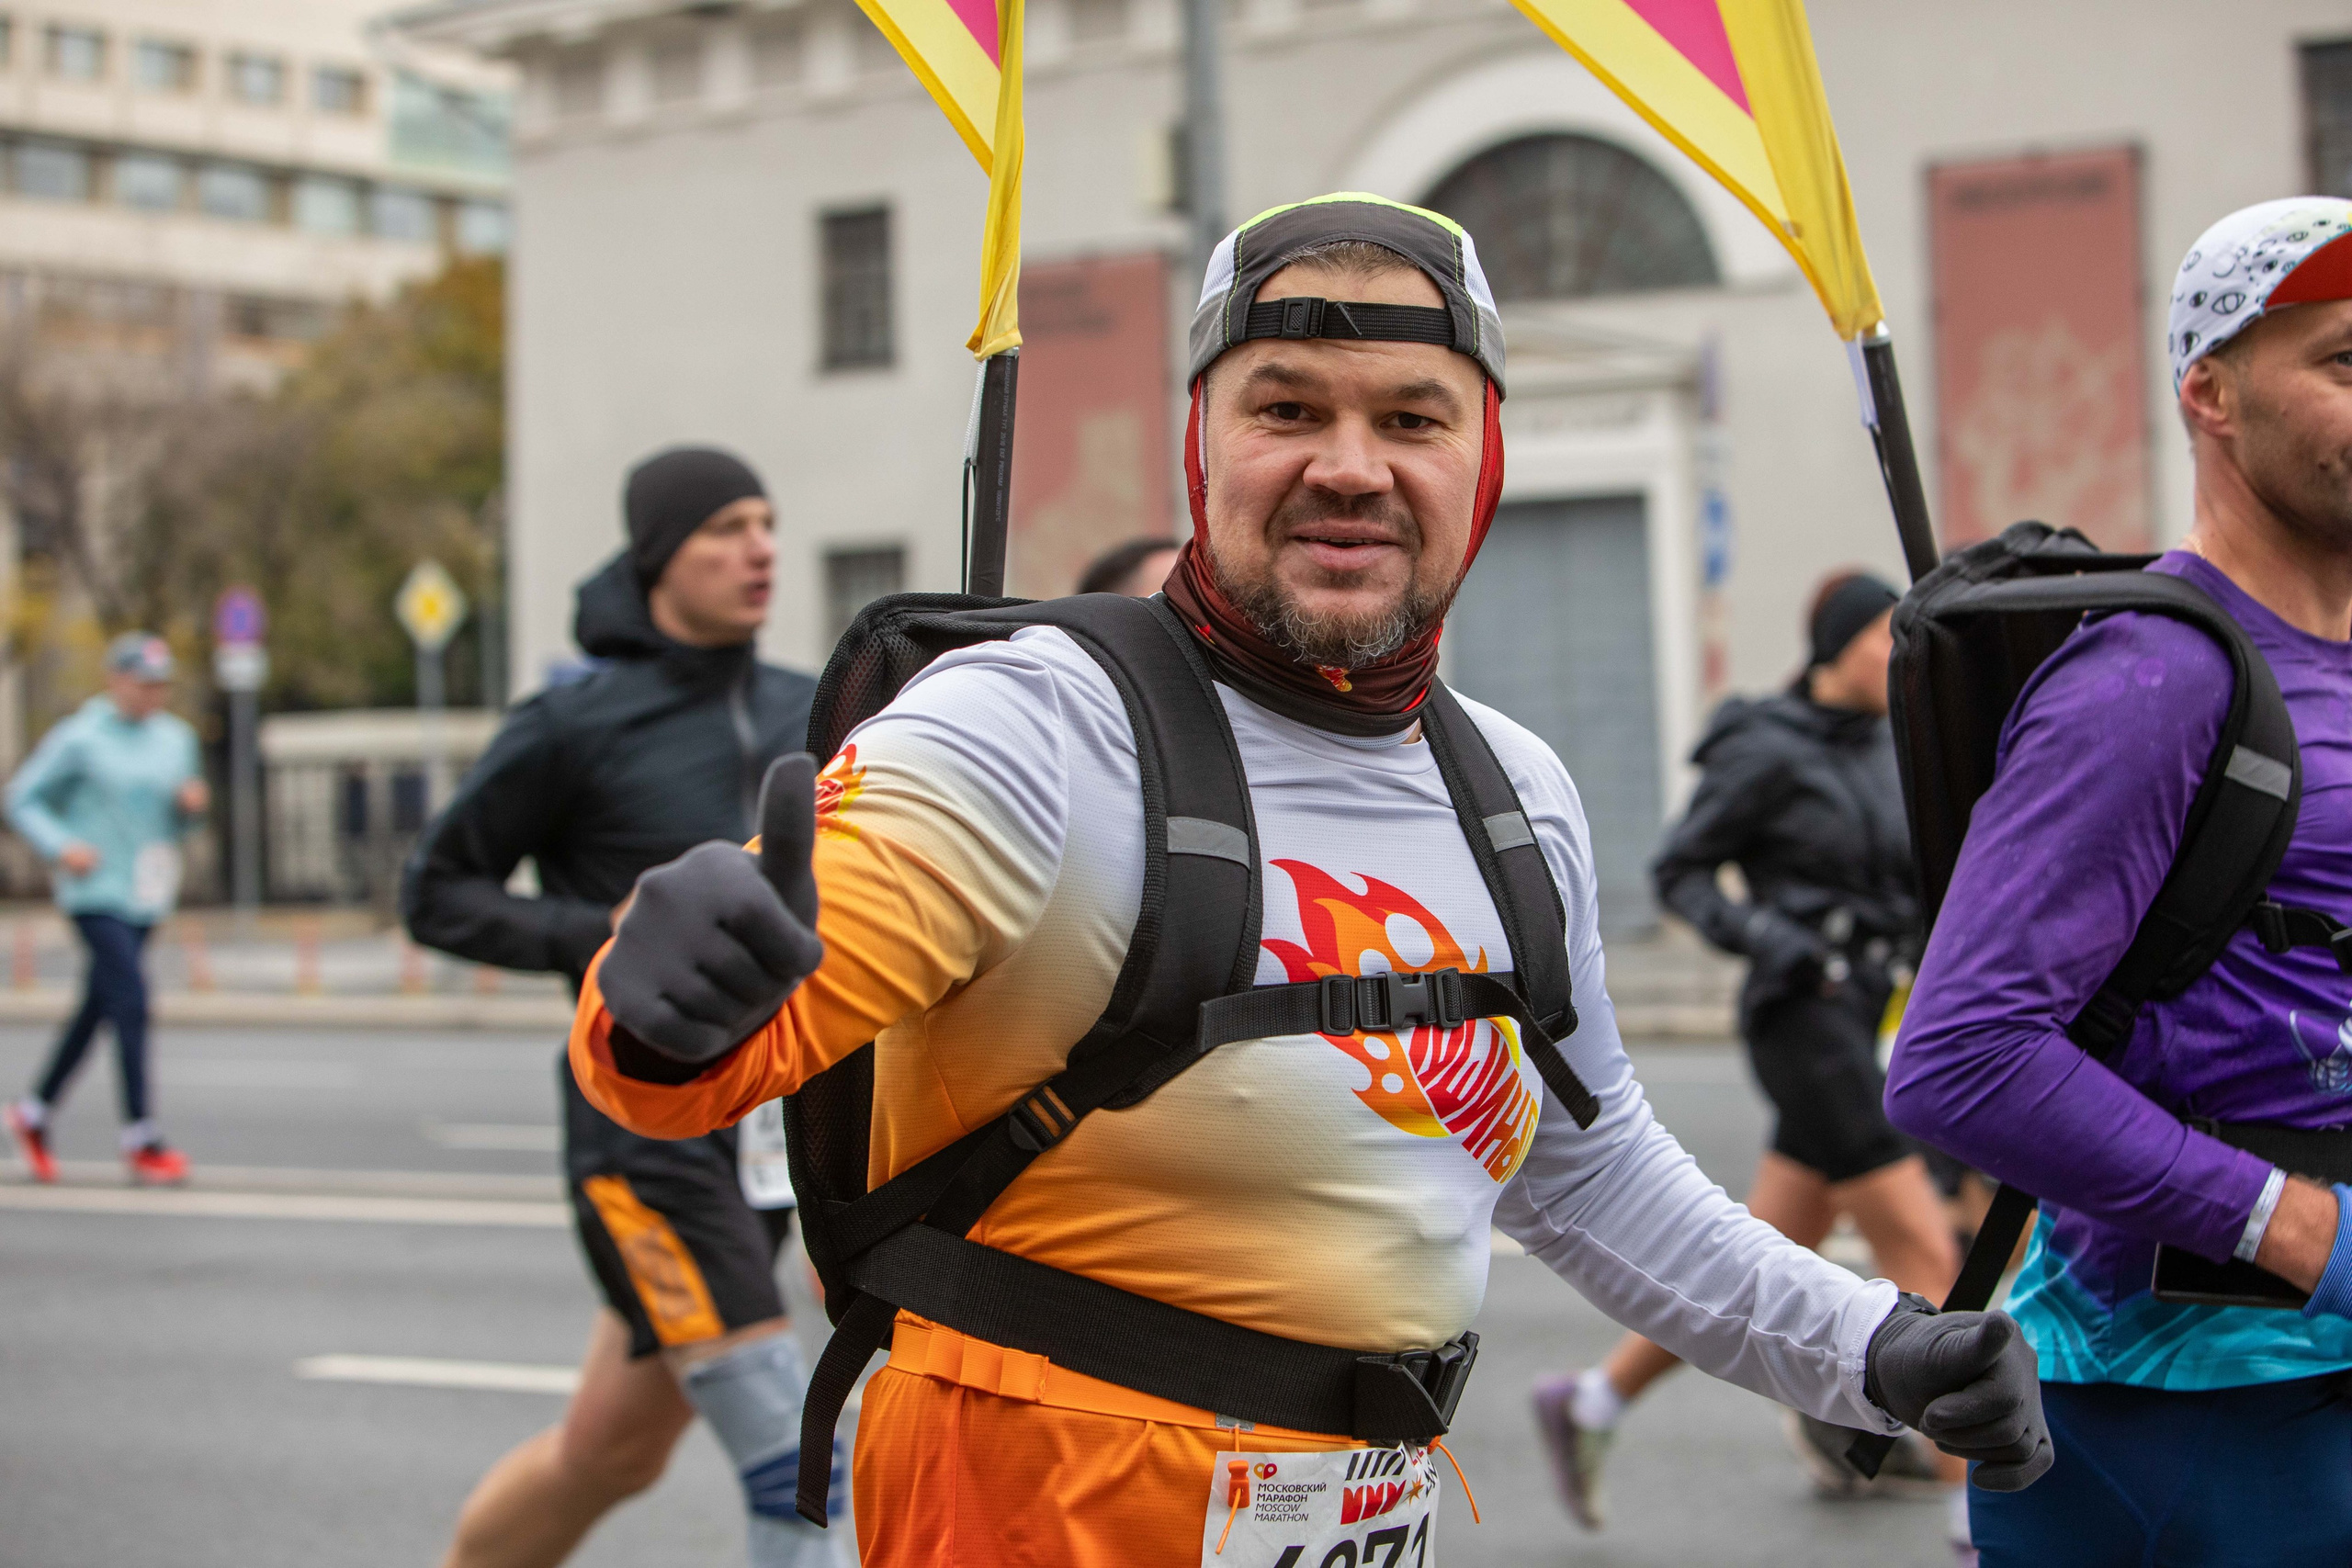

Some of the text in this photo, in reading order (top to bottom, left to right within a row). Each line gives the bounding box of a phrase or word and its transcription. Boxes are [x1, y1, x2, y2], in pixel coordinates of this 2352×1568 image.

[1257, 1482, 1327, 1494] МОСКОВСКИЙ
[1256, 1493, 1308, 1503] МАРАФОН
[1255, 1503, 1302, 1513] MOSCOW
[1254, 1513, 1309, 1522] MARATHON
